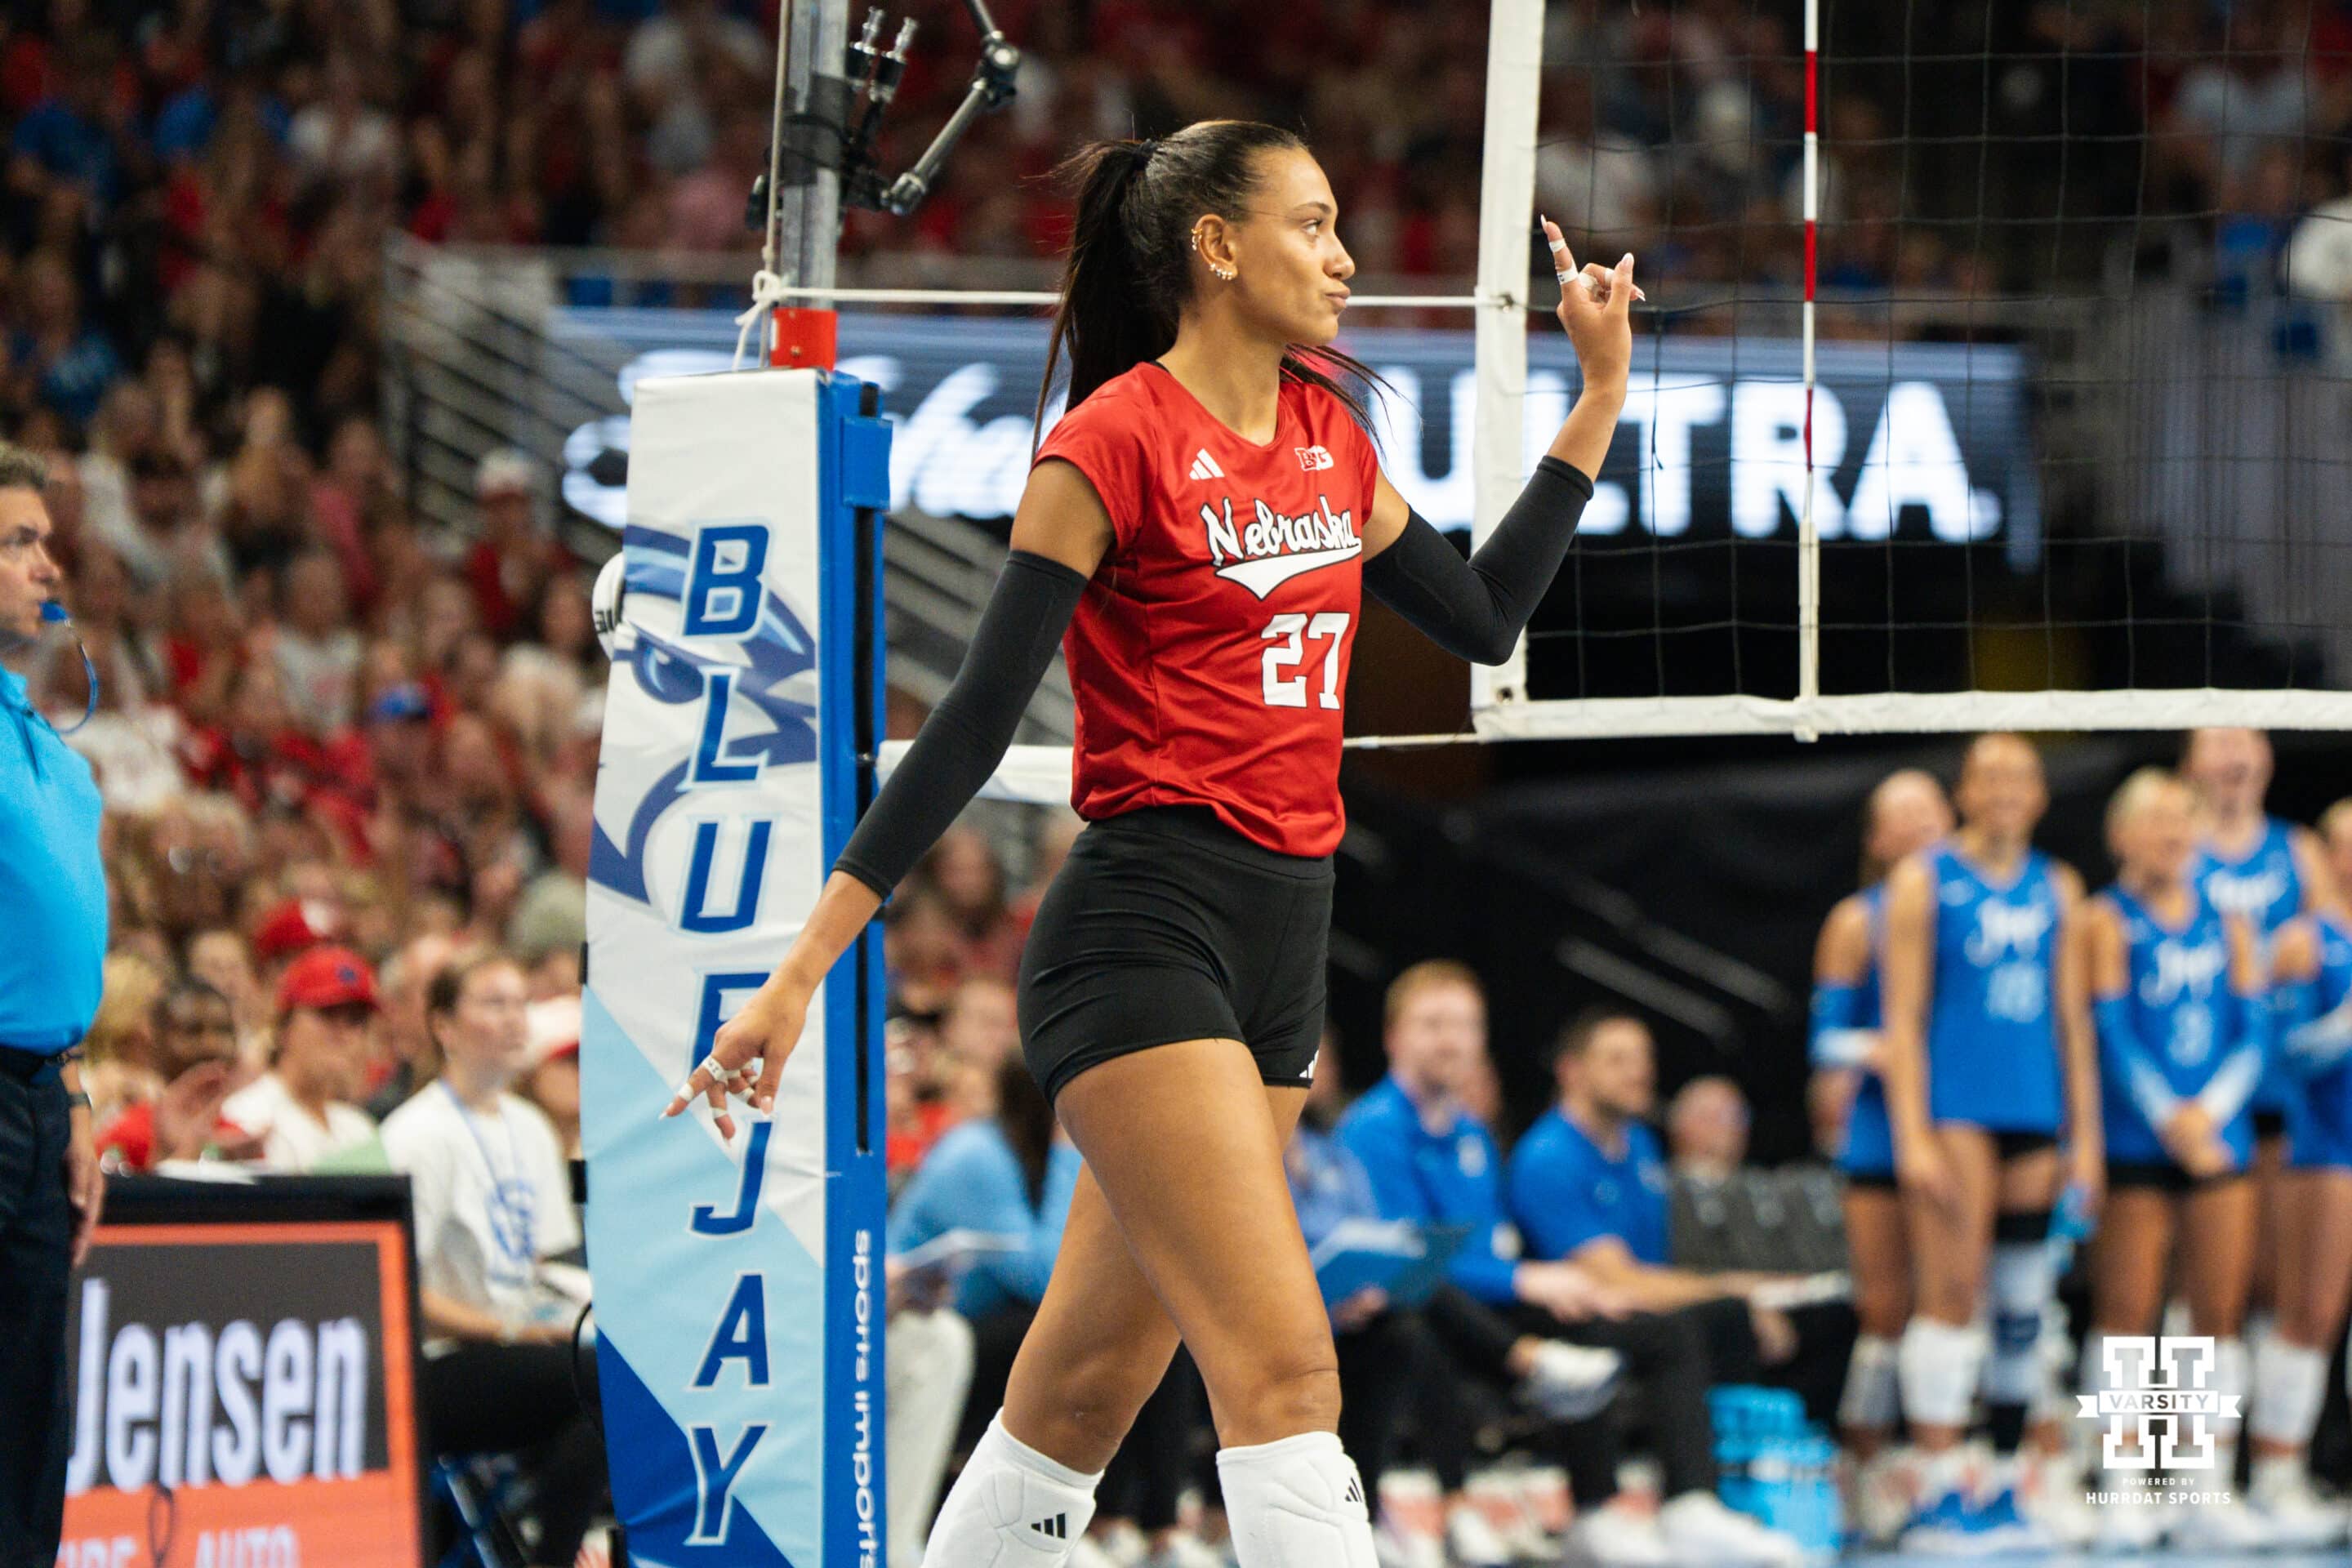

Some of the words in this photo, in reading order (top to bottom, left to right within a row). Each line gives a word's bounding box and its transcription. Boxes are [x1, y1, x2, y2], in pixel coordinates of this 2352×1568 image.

[1200, 494, 1362, 570] Nebraska
[1261, 612, 1351, 710] 27
[853, 1228, 871, 1383] sports
[65, 1276, 368, 1497] Jensen
